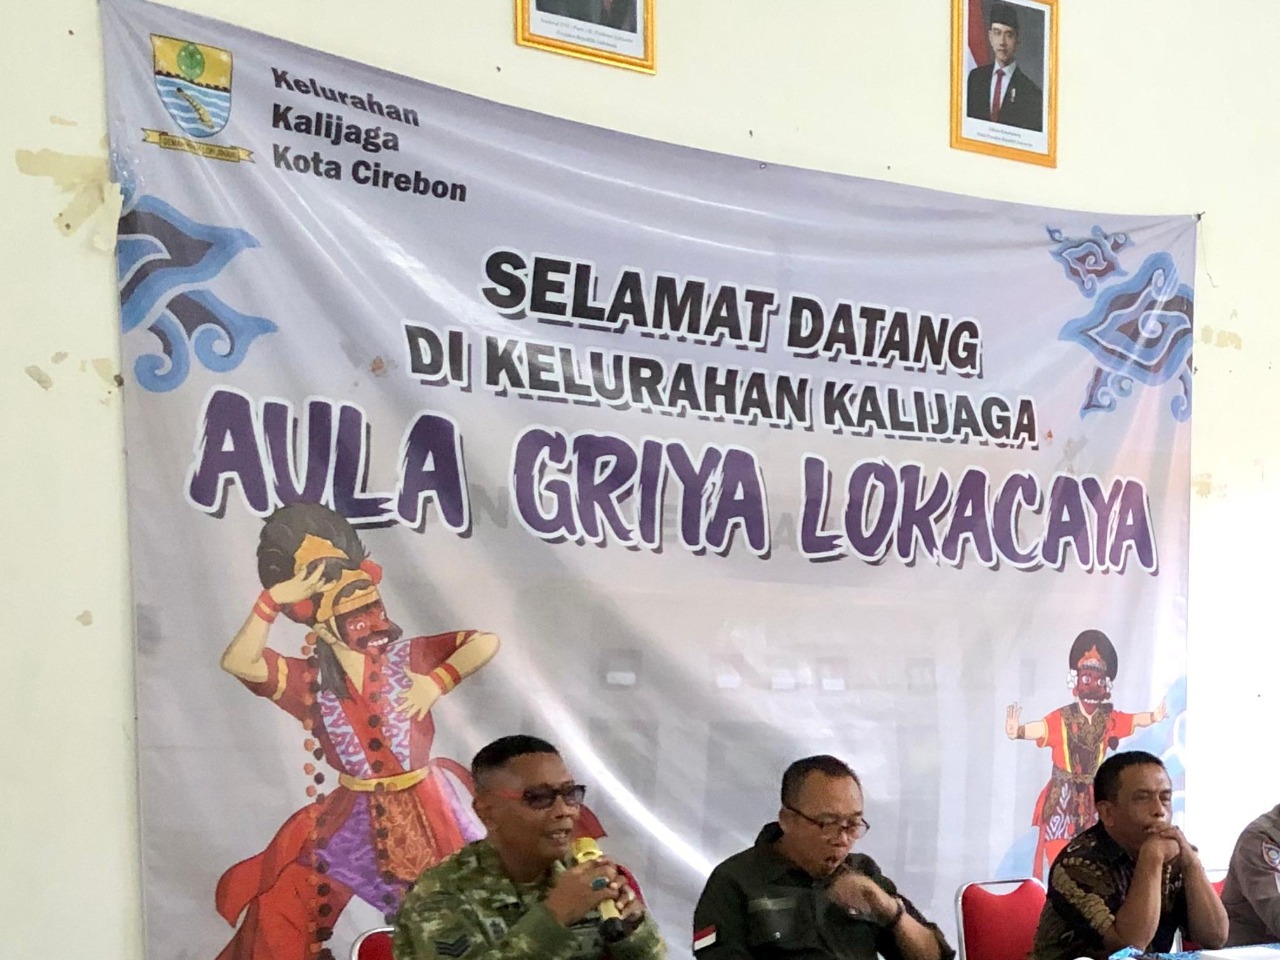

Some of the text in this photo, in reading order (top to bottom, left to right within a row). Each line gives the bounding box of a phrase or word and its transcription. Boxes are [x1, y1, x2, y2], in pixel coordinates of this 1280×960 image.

[272, 67, 420, 127] Kelurahan
[272, 104, 399, 153] Kalijaga
[272, 144, 342, 181] Kota
[352, 159, 467, 202] Cirebon
[483, 251, 982, 372] SELAMAT DATANG
[405, 324, 1037, 443] DI KELURAHAN KALIJAGA
[189, 391, 1158, 572] AULA GRIYA LOKACAYA
